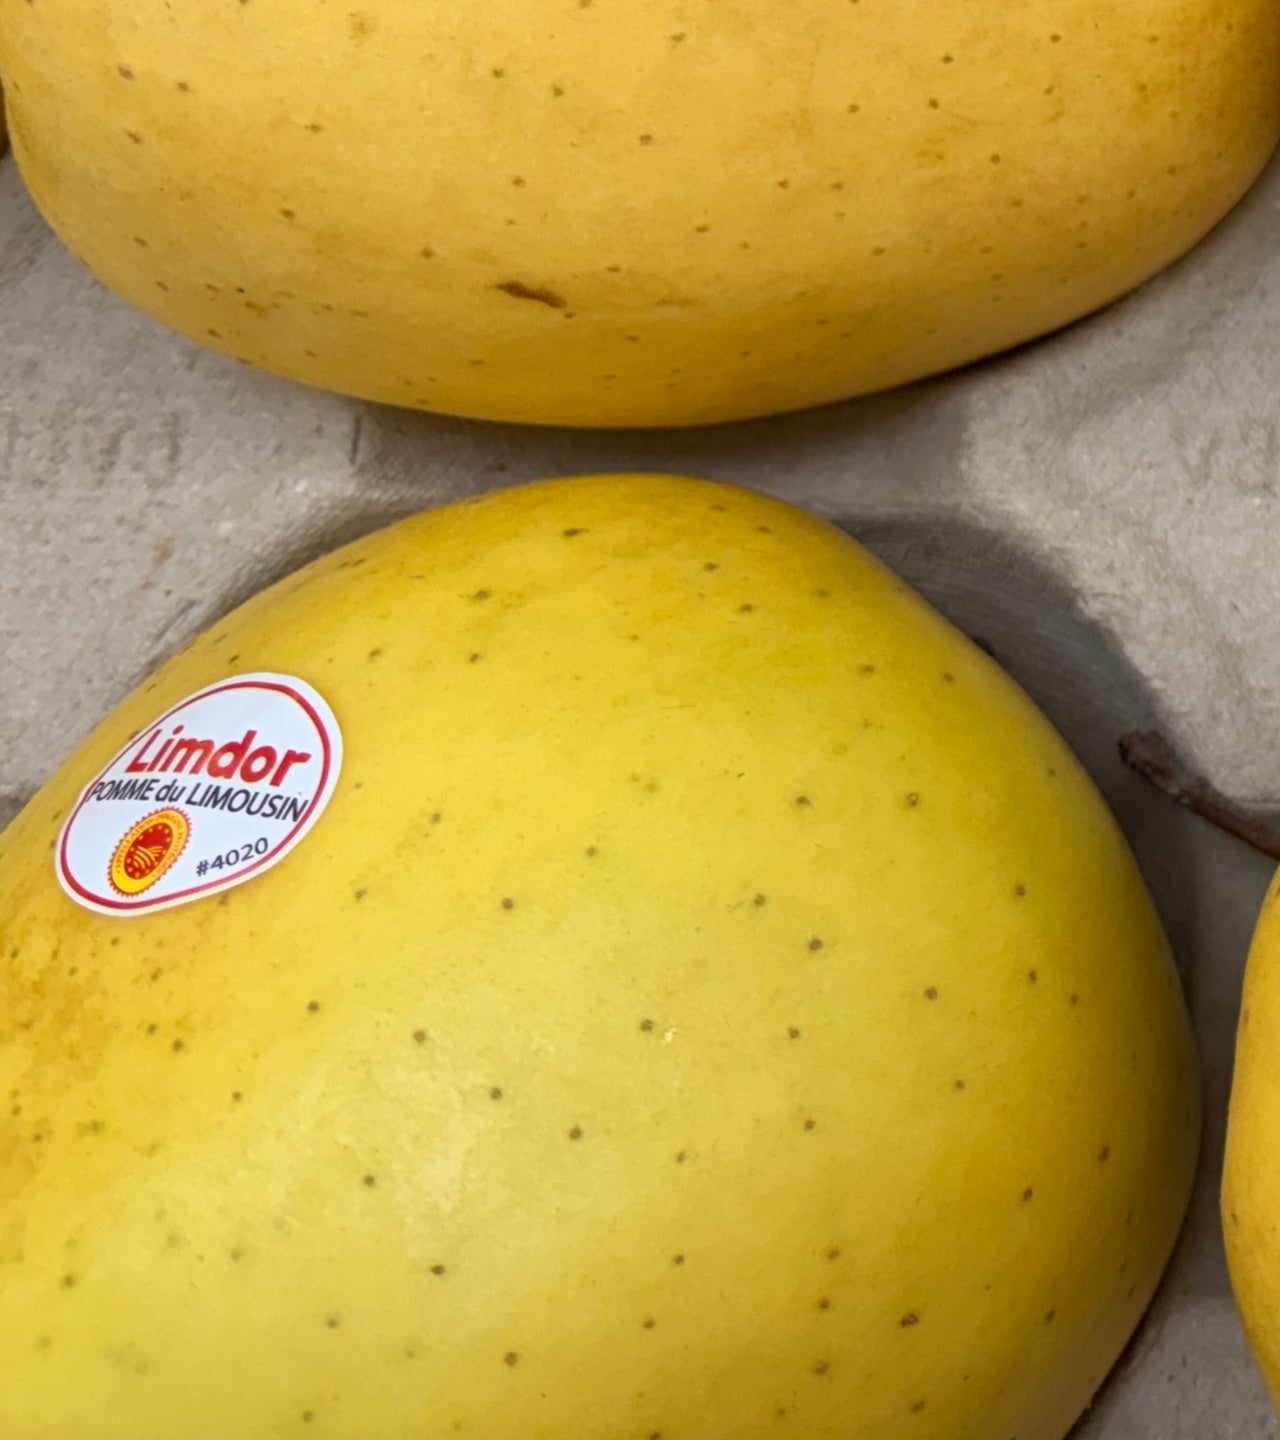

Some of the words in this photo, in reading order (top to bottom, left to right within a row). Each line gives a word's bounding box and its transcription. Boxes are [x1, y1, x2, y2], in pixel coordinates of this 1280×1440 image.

[125, 725, 312, 787] Limdor
[86, 778, 160, 803] POMME
[155, 778, 186, 802] du
[185, 783, 309, 822] LIMOUSIN
[196, 837, 269, 877] #4020
